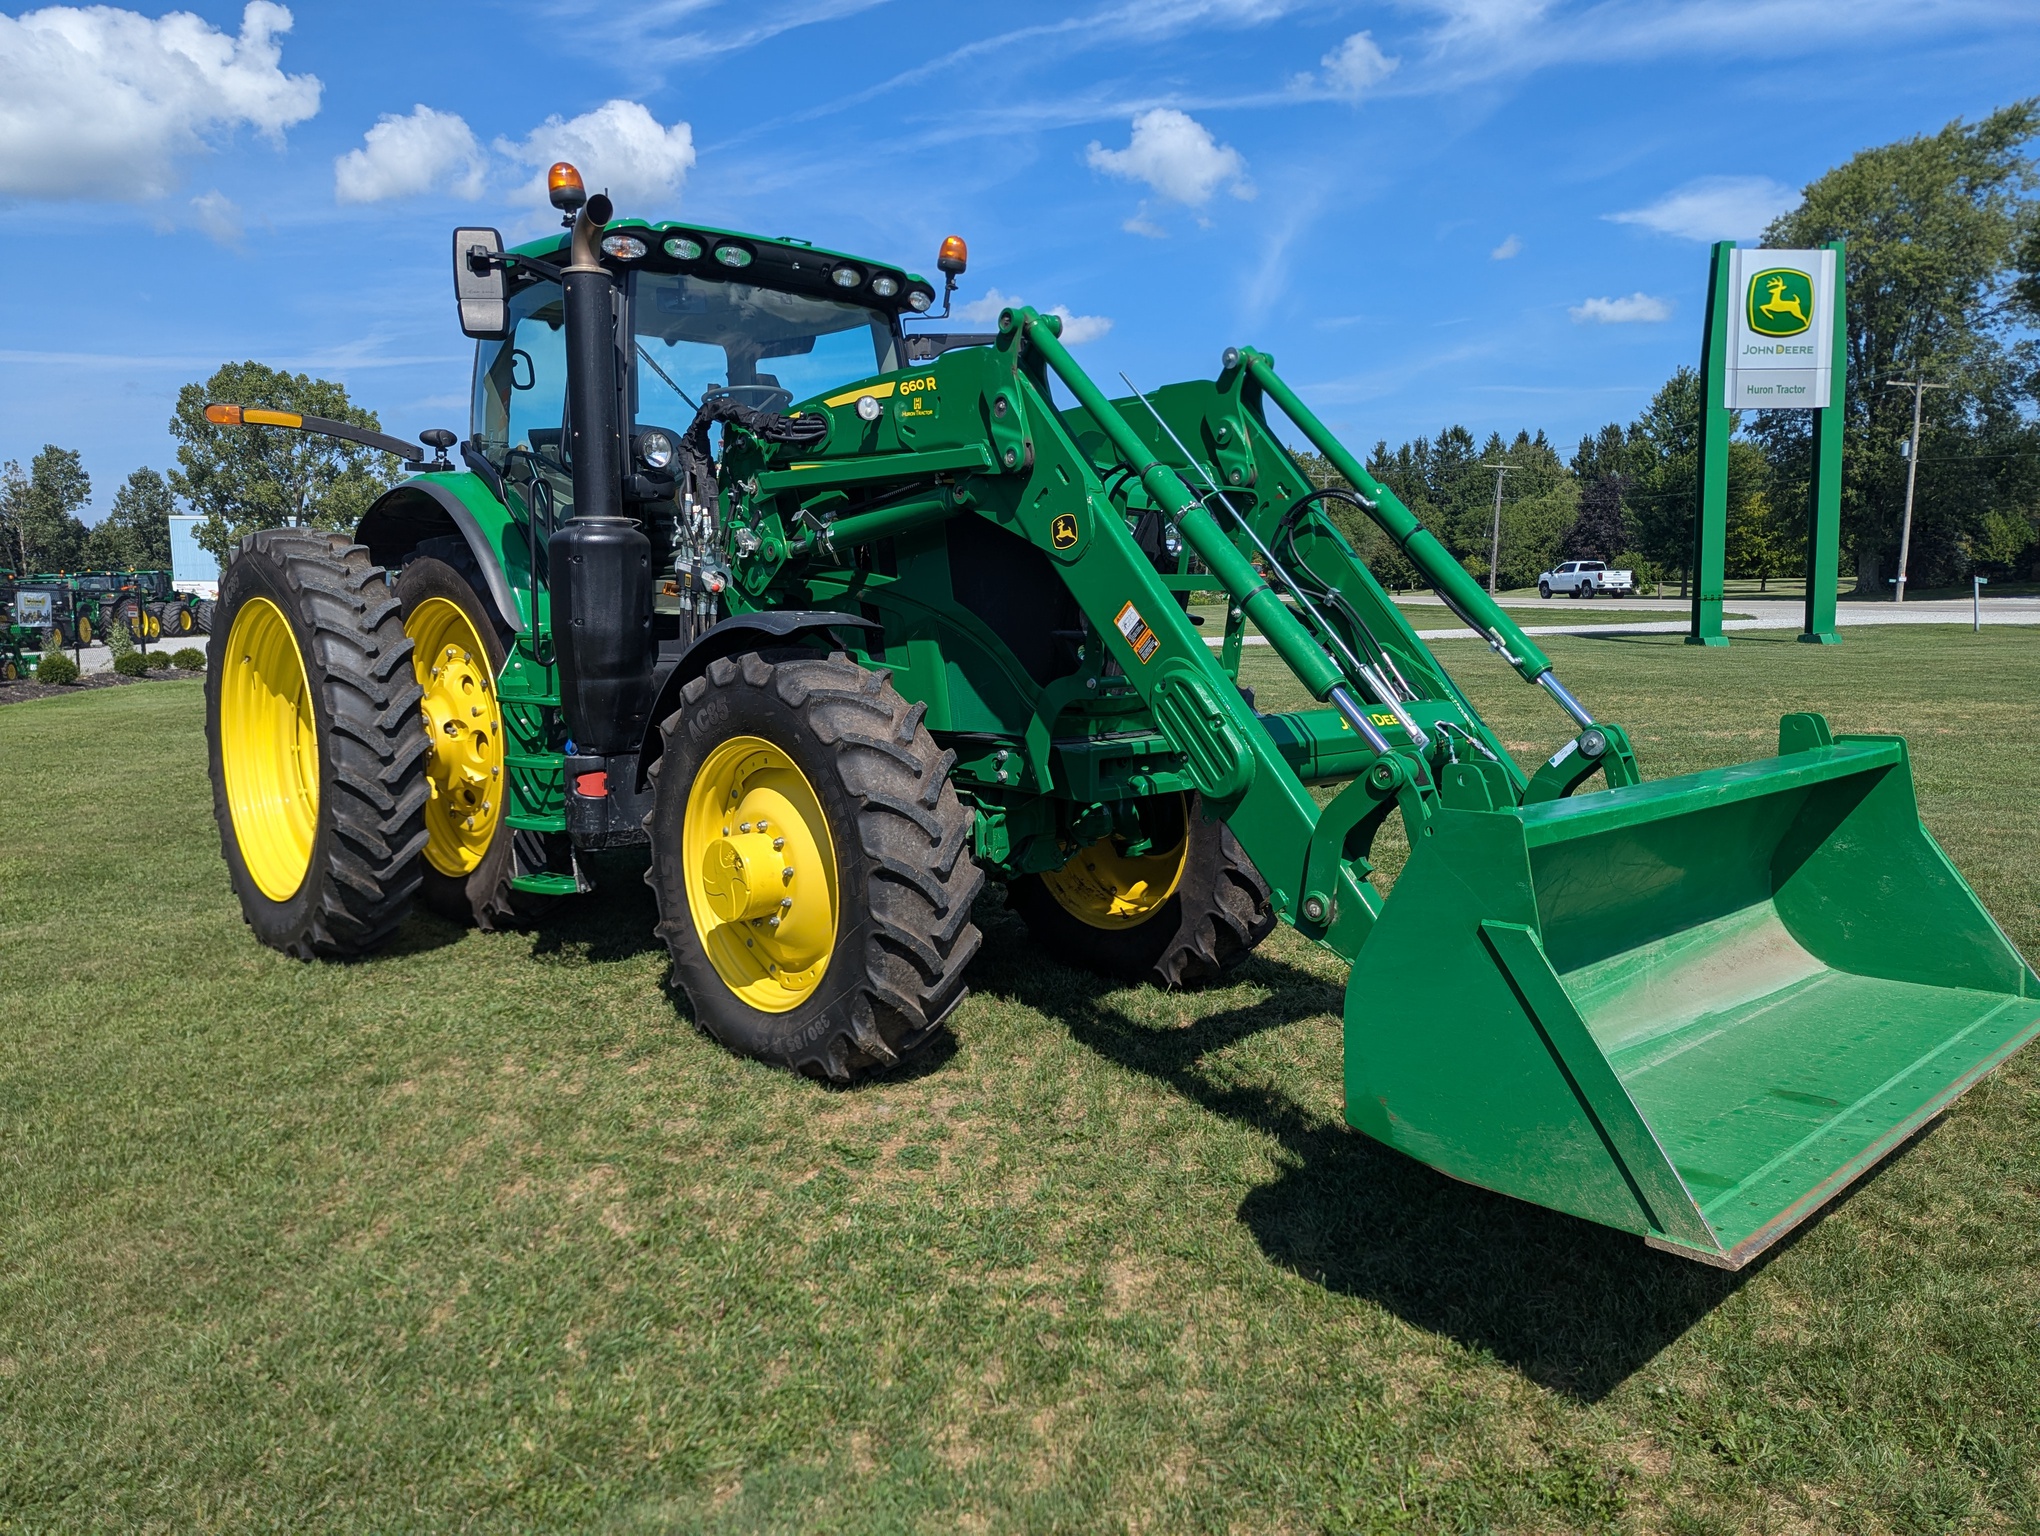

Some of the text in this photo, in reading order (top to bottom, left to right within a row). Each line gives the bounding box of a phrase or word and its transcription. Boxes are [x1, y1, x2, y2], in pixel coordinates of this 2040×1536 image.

[1742, 344, 1814, 354] JOHN DEERE
[900, 376, 937, 395] 660 R
[1747, 385, 1806, 394] Huron Tractor
[688, 697, 729, 743] AC85
[1371, 713, 1416, 726] DEE
